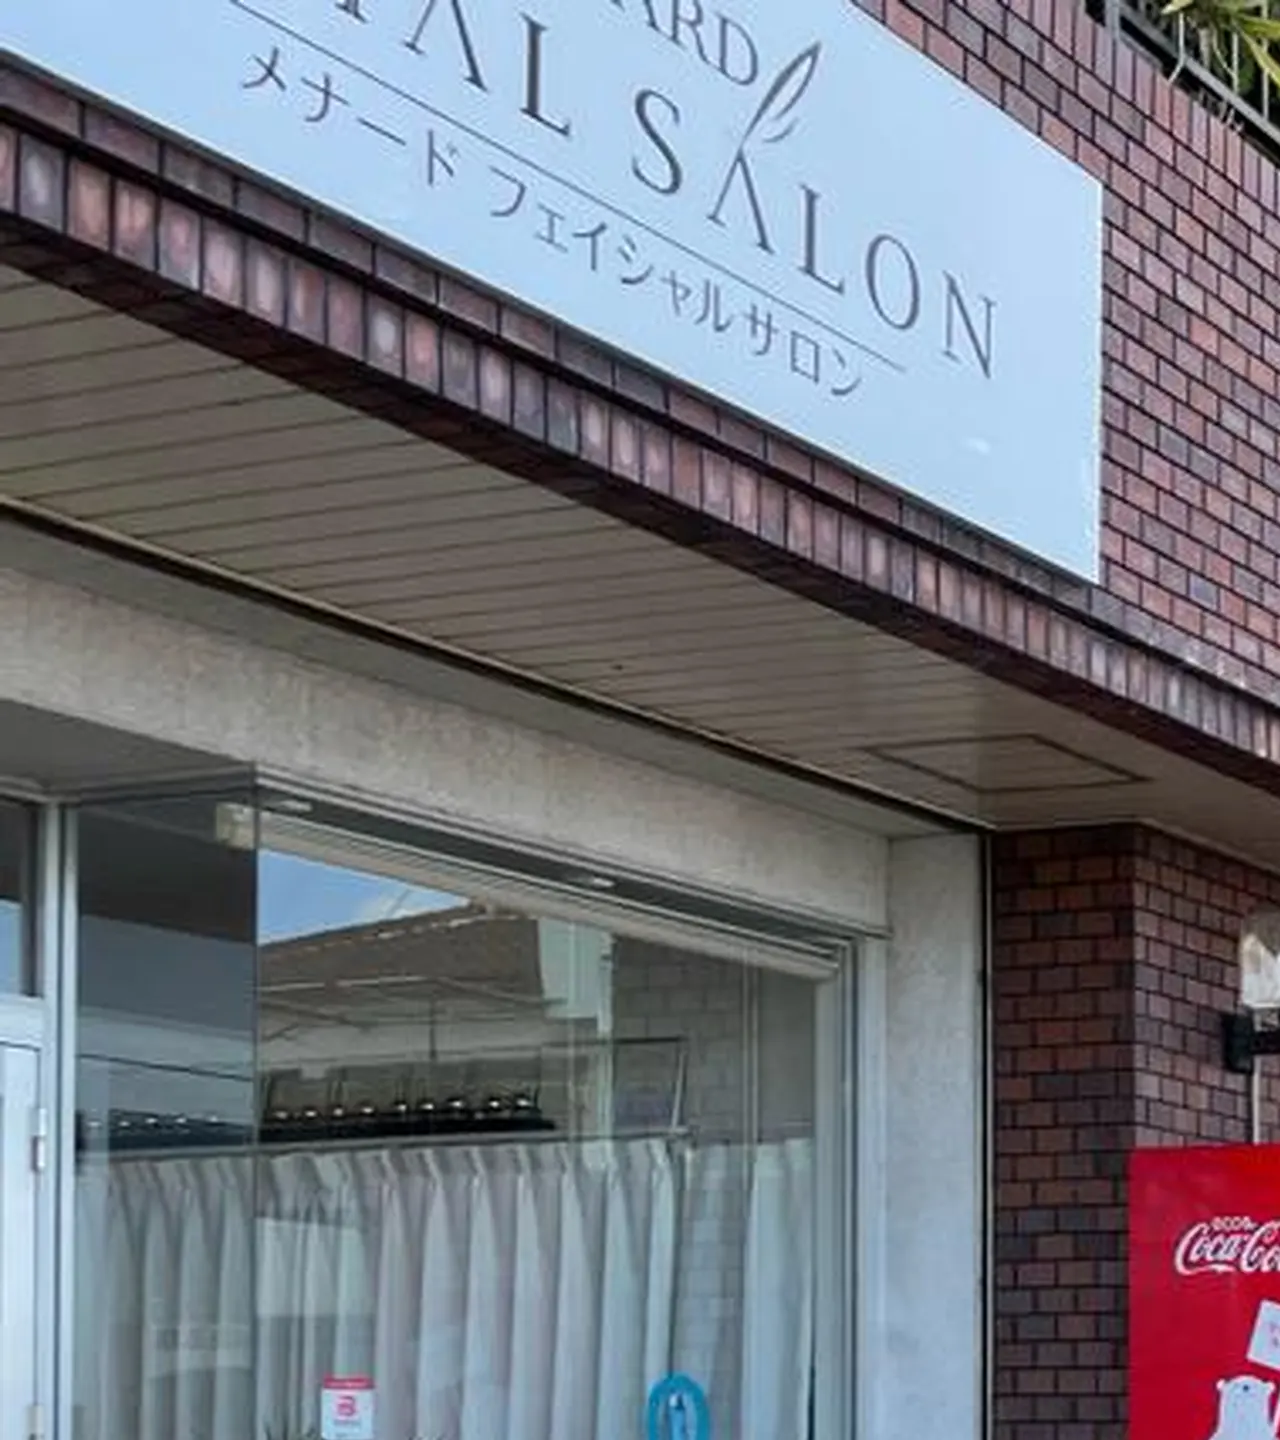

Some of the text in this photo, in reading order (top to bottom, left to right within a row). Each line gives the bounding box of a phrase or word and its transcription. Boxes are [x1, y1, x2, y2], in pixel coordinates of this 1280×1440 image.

[242, 46, 864, 397] メナード フェイシャルサロン
[631, 87, 999, 379] SALON
